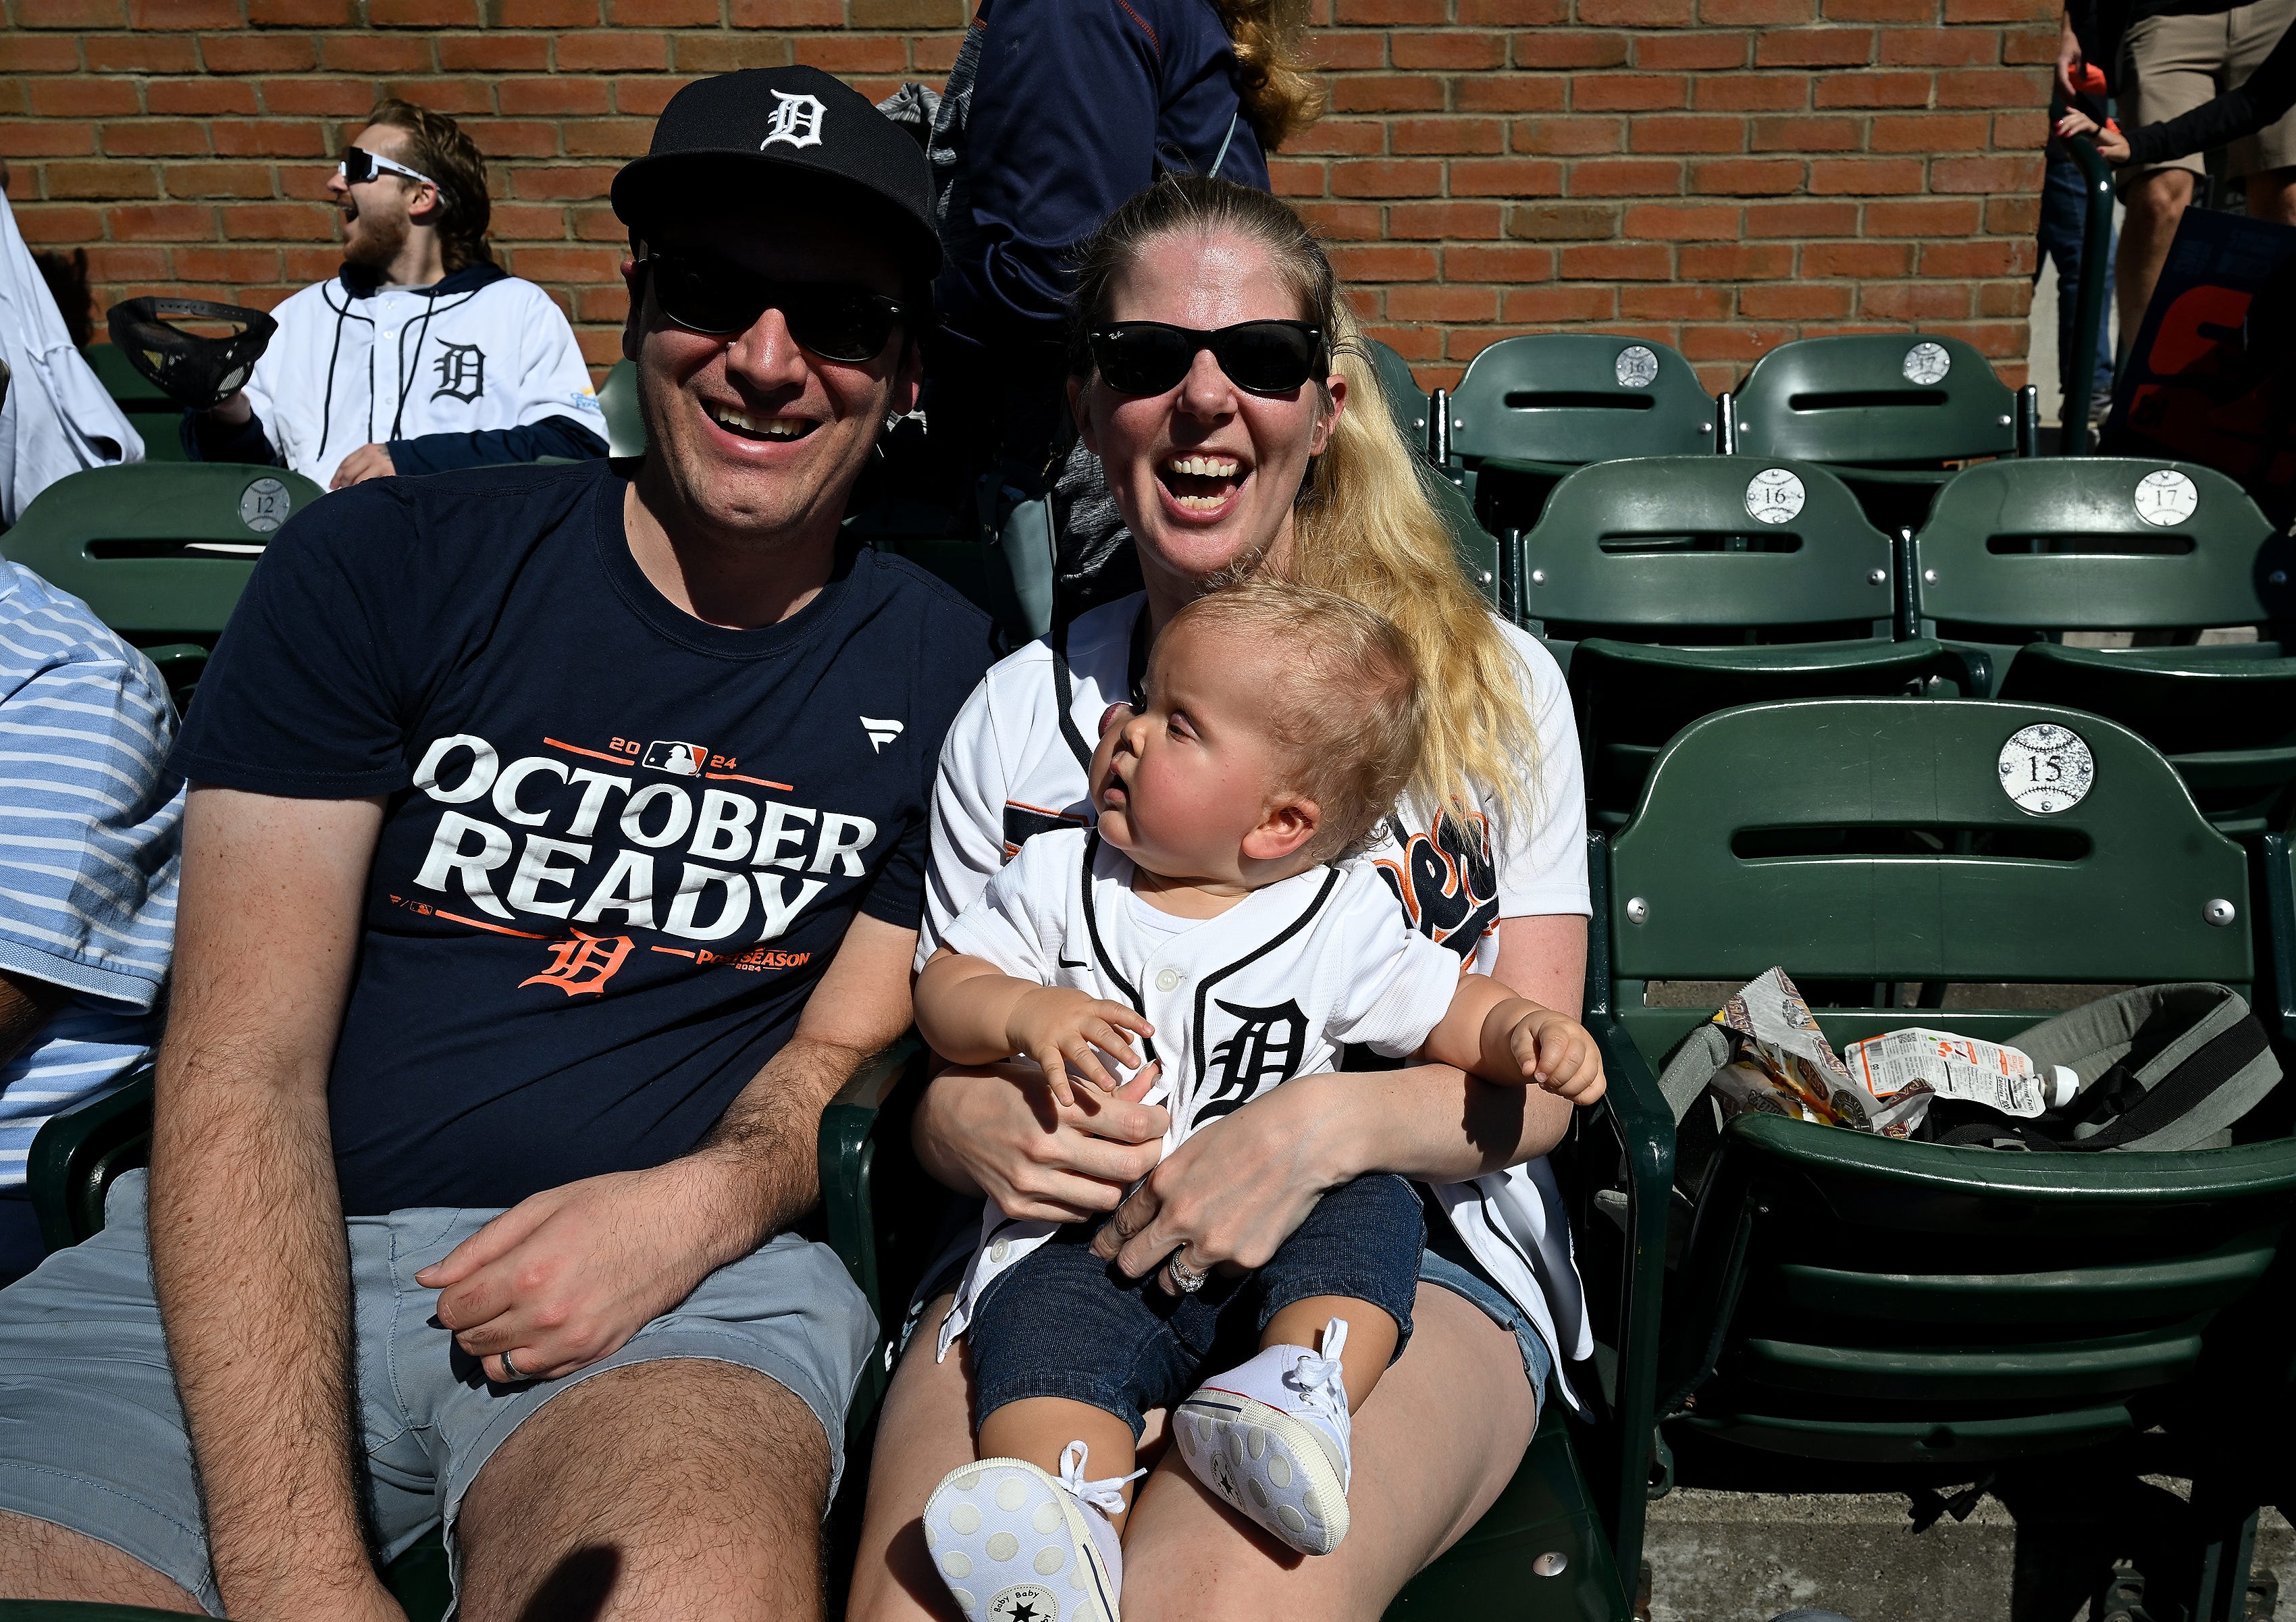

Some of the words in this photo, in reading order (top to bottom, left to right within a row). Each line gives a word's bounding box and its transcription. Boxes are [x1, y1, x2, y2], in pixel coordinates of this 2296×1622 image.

[760, 88, 828, 151] D
[430, 336, 487, 404] D
[1629, 360, 1645, 374] 16
[257, 496, 274, 513] 12
[1766, 488, 1785, 504] 16
[2157, 490, 2177, 506] 17
[609, 737, 640, 756] 20
[710, 754, 736, 771] 24
[2029, 756, 2062, 782] 15
[412, 733, 877, 877] OCTOBER
[412, 810, 828, 943] READY
[517, 928, 635, 997] D
[696, 948, 811, 967] POSTSEASON
[735, 964, 761, 972] 2024
[1191, 997, 1310, 1131] D
[2001, 1099, 2011, 1109] 100
[2026, 1099, 2034, 1111] Facts
[993, 1596, 1010, 1613] Baby
[1015, 1589, 1039, 1599] Baby
